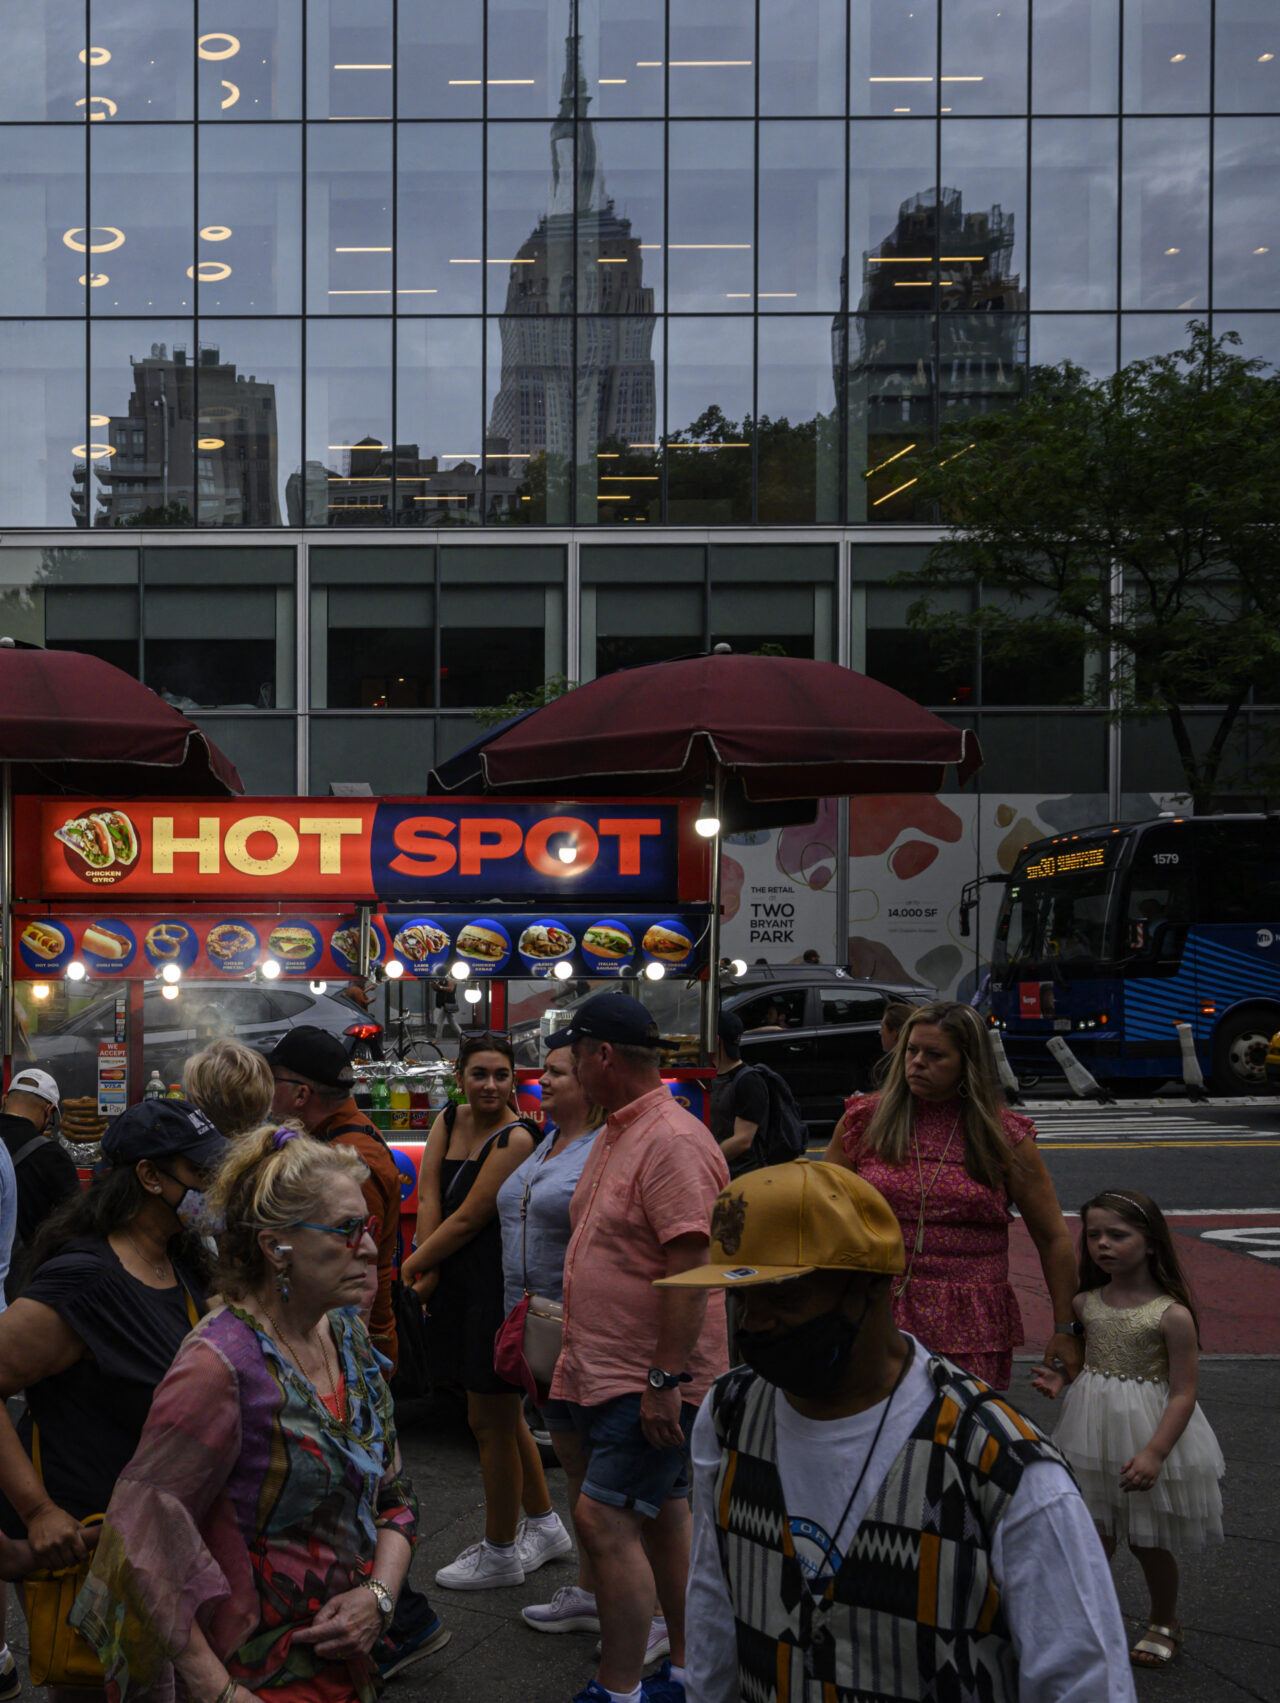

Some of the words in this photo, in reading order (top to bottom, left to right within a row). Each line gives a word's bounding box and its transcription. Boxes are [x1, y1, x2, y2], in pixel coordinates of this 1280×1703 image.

[152, 815, 362, 876] HOT
[389, 816, 661, 876] SPOT
[1152, 853, 1180, 864] 1579
[750, 903, 795, 917] TWO
[924, 908, 938, 918] SF
[750, 919, 795, 928] BRYANT
[750, 930, 795, 943] PARK
[109, 1104, 124, 1113] Pay
